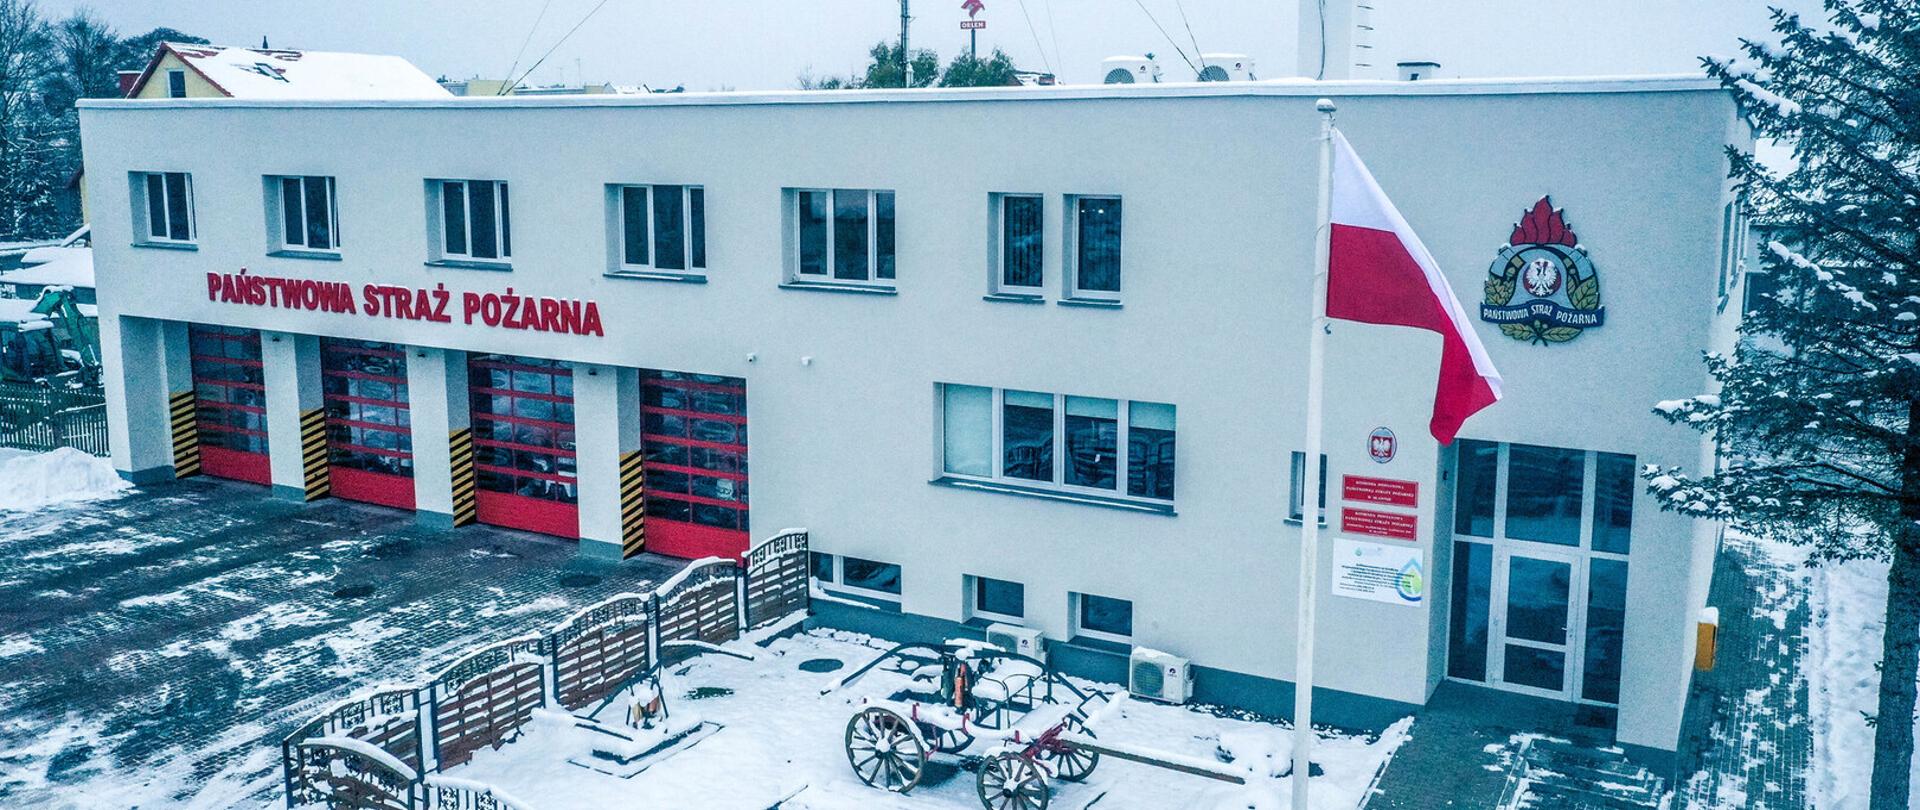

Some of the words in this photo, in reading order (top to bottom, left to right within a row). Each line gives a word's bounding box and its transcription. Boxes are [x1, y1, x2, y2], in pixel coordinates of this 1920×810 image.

[207, 268, 356, 314] PAŃSTWOWA
[363, 282, 451, 323] STRAŻ
[463, 287, 604, 337] POŻARNA
[1483, 307, 1529, 320] PAŃSTWOWA
[1531, 304, 1553, 316] STRAŻ
[1556, 310, 1598, 324] POŻARNA
